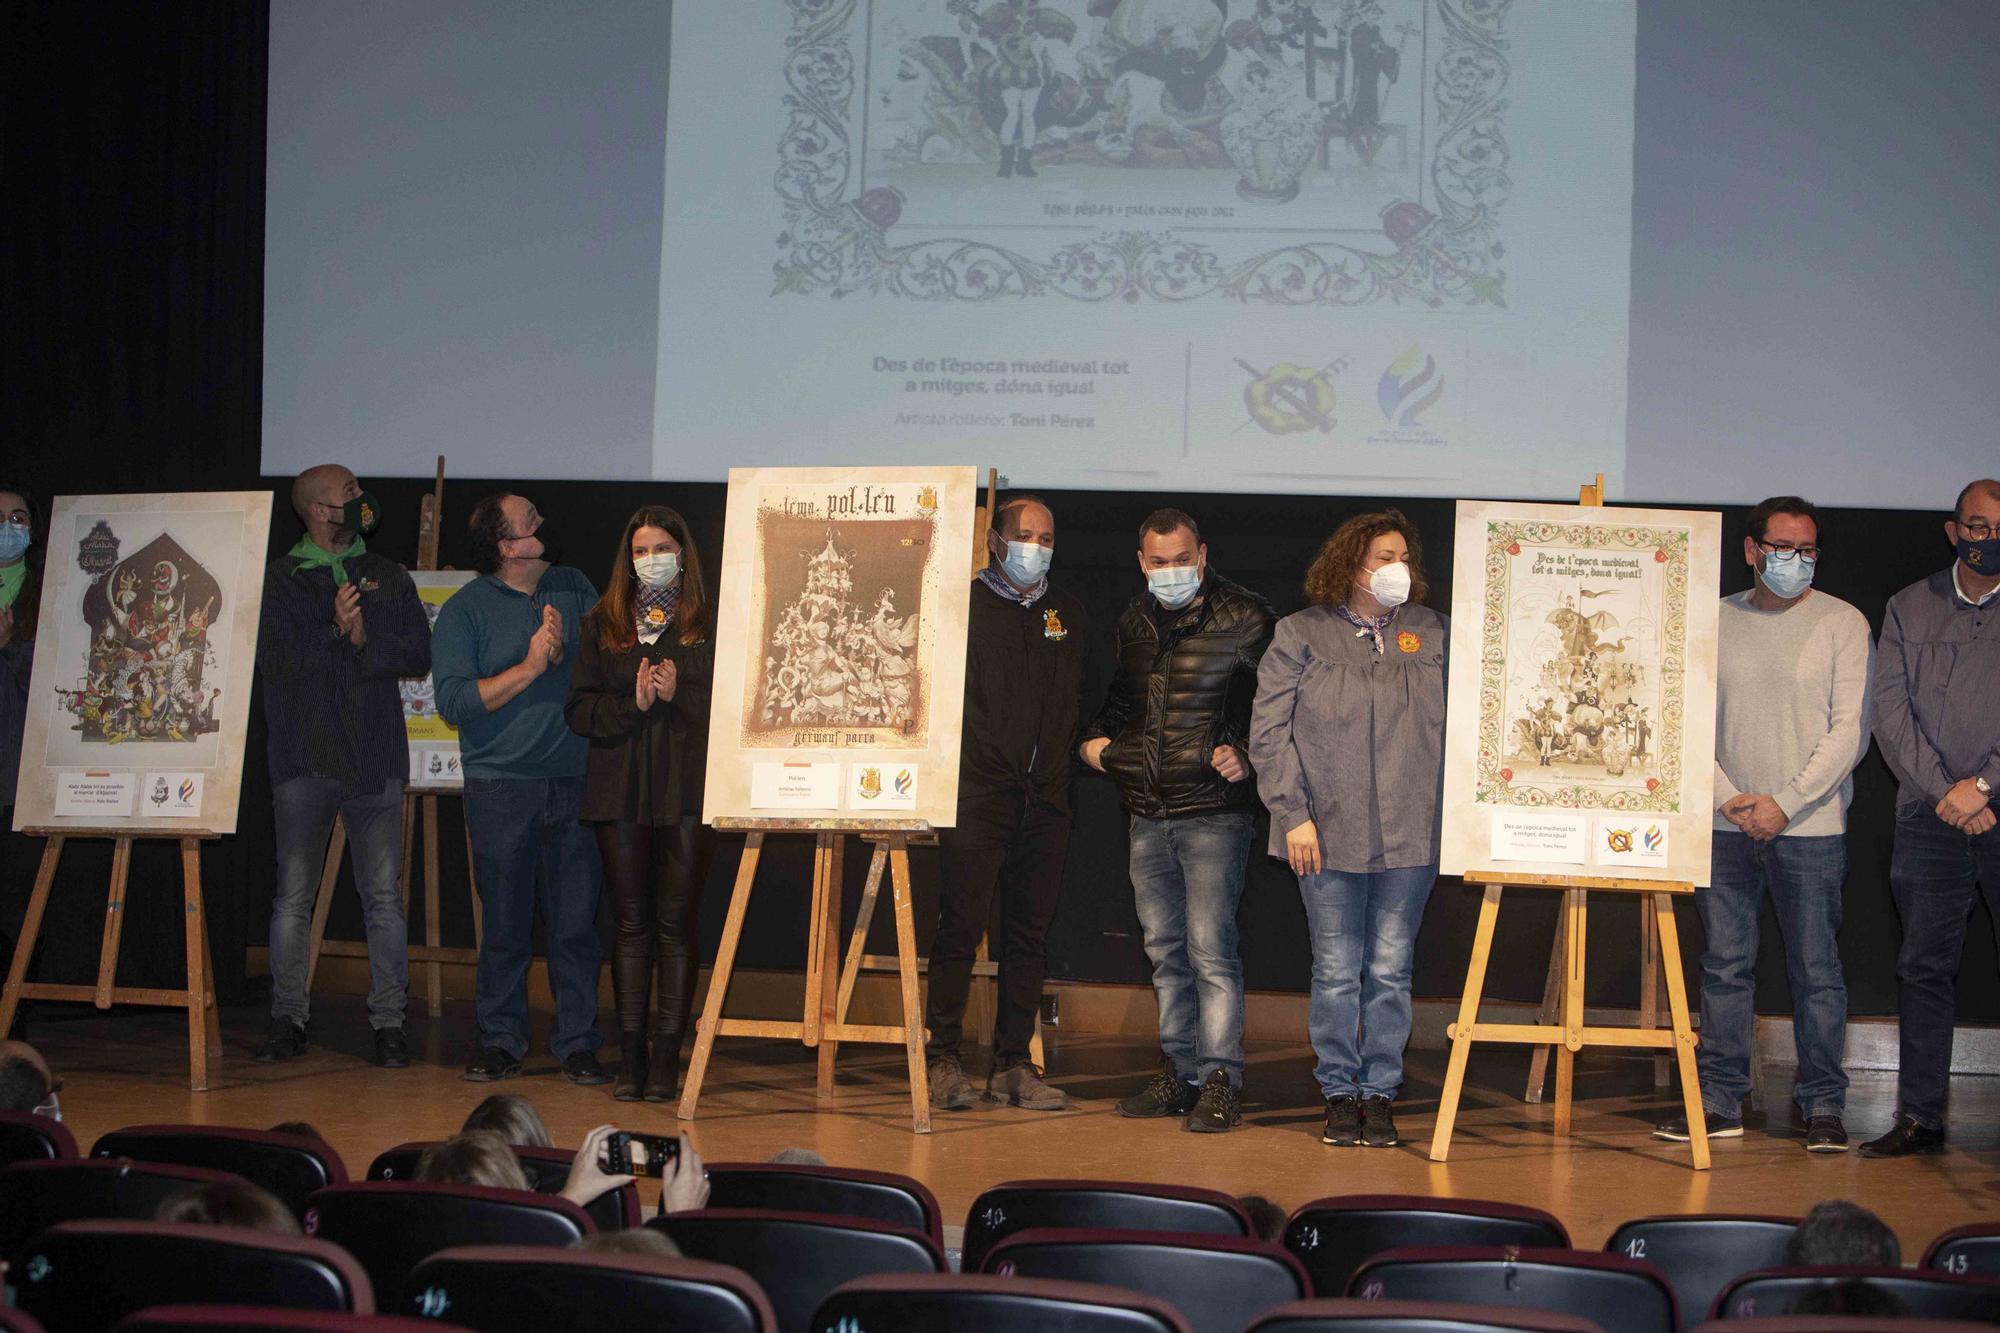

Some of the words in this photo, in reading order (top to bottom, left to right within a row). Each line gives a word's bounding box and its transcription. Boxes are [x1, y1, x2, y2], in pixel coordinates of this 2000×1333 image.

[873, 356, 907, 372] Des
[912, 357, 936, 372] de
[1011, 359, 1098, 374] medieval
[1102, 360, 1129, 374] tot
[905, 380, 917, 392] a
[921, 379, 988, 396] mitges,
[1048, 380, 1095, 397] igual
[1009, 413, 1047, 427] Toni
[1535, 552, 1554, 566] Des
[1556, 555, 1566, 565] de
[1601, 557, 1639, 568] medieval
[1532, 565, 1545, 574] tot
[1556, 566, 1589, 578] mitges,
[1625, 1238, 1646, 1259] 12
[1943, 1253, 1969, 1275] 13
